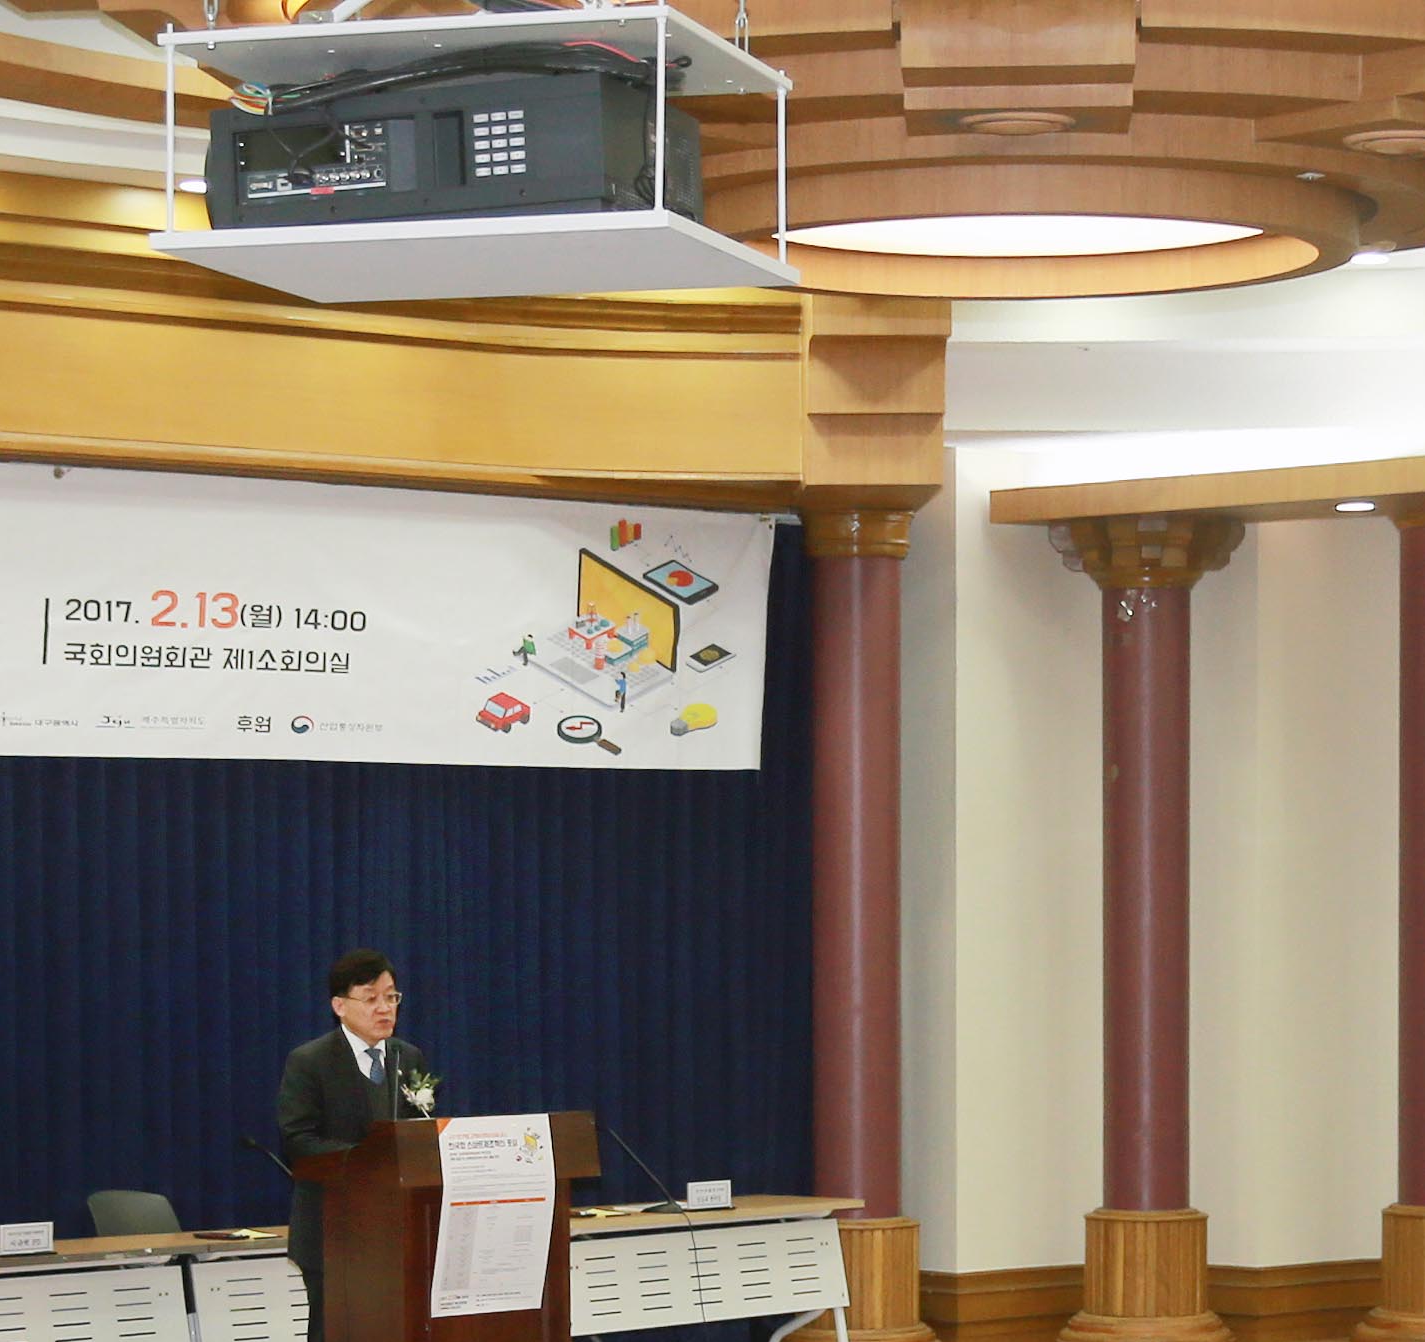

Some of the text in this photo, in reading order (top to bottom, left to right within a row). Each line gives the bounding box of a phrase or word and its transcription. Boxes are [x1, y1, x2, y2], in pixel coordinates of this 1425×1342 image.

[64, 598, 140, 624] 2017.
[294, 607, 368, 632] 14:00
[63, 642, 351, 675] 국회의원회관 제1소회의실
[236, 715, 272, 733] 후원
